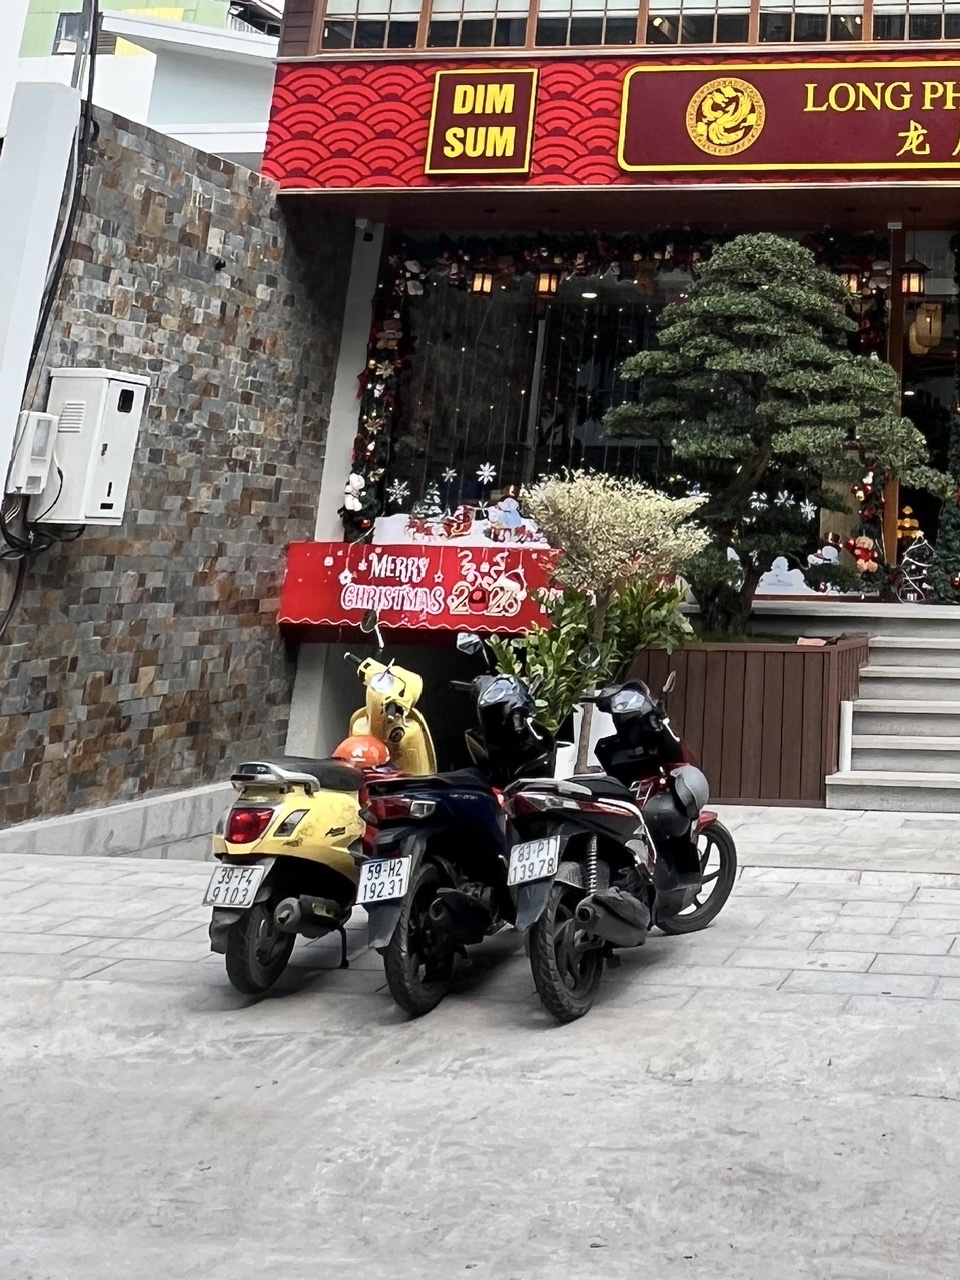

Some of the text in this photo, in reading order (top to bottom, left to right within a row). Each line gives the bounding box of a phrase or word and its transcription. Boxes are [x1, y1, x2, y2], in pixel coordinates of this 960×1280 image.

[452, 83, 515, 115] DIM
[804, 81, 912, 113] LONG
[443, 126, 516, 158] SUM
[368, 551, 430, 583] MERRY
[340, 583, 445, 615] CHRISTMAS
[218, 868, 252, 886] 39-F4
[366, 860, 403, 881] 59-H2
[210, 886, 249, 904] 9103
